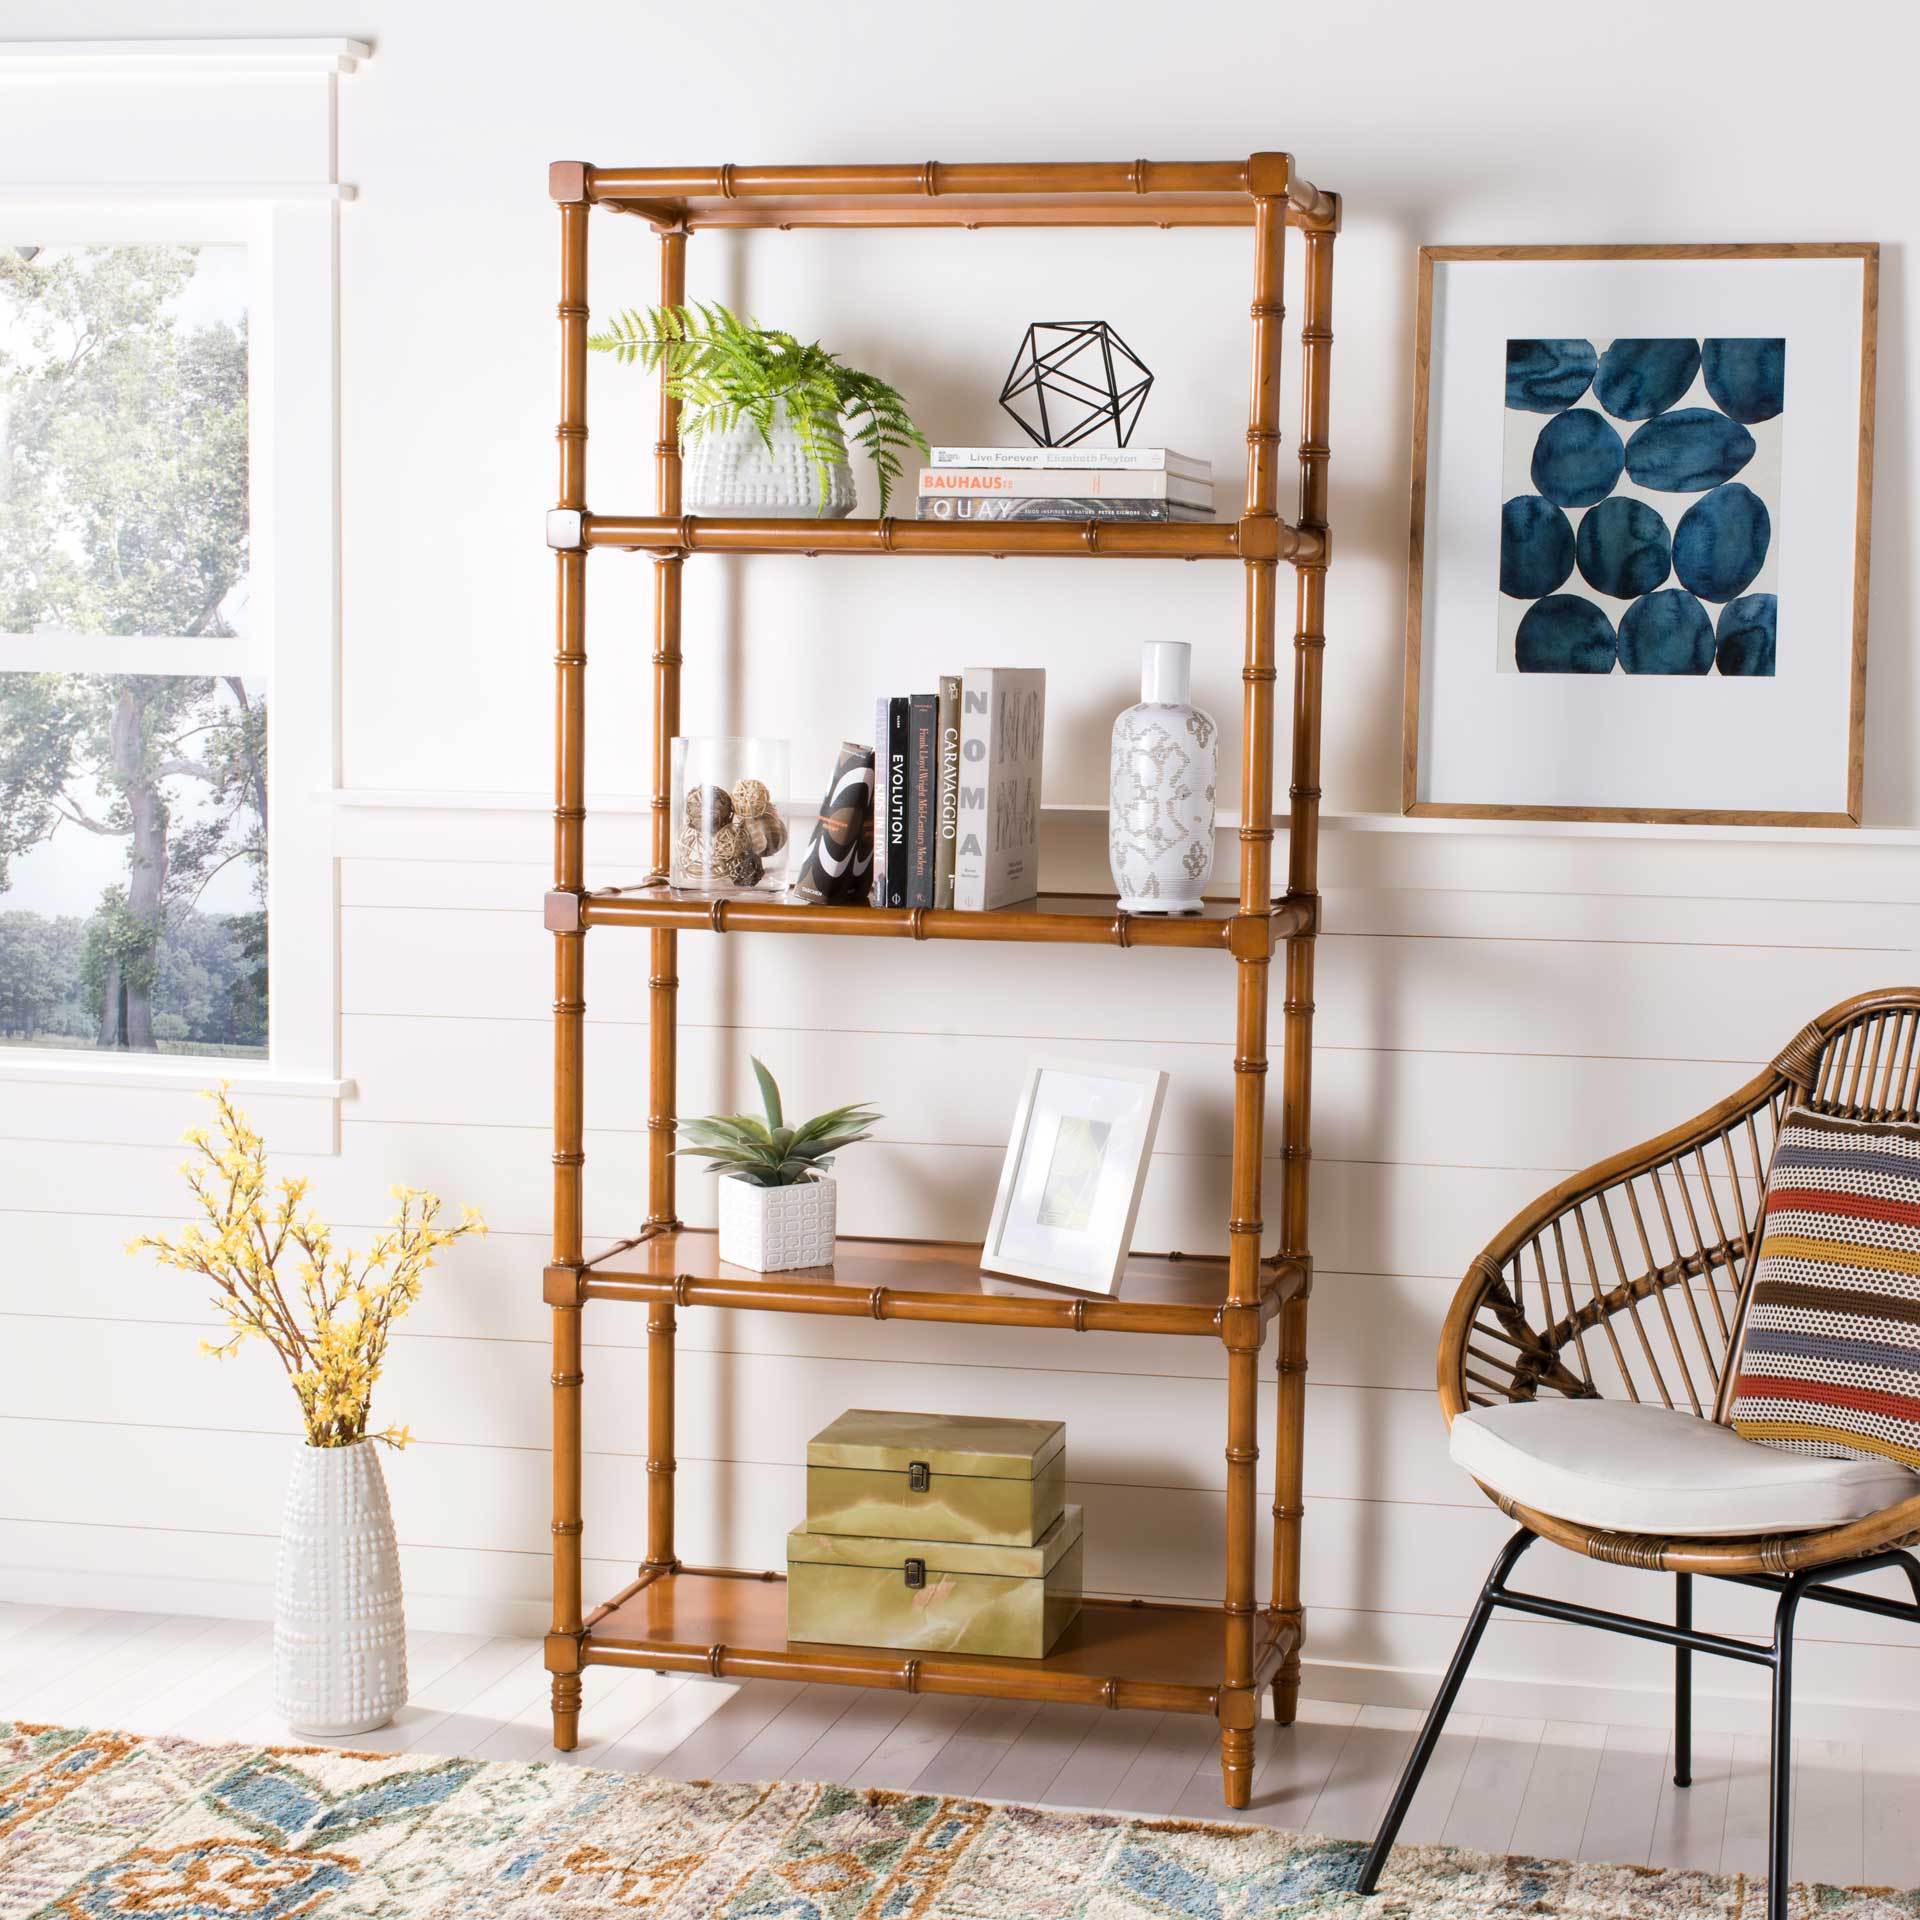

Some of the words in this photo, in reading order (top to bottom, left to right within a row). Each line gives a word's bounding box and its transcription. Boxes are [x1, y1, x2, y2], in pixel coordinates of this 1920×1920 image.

[970, 453, 992, 462] Live
[995, 453, 1038, 462] Forever
[1100, 454, 1137, 464] Peyton
[933, 500, 1011, 518] QUAY
[919, 728, 929, 750] Frank
[918, 751, 928, 771] Lloyd
[917, 772, 928, 797] Wright
[942, 728, 958, 840] CARAVAGGIO
[891, 754, 903, 844] EVOLUTION
[917, 799, 928, 846] Mid-Century
[917, 846, 928, 876] Modern
